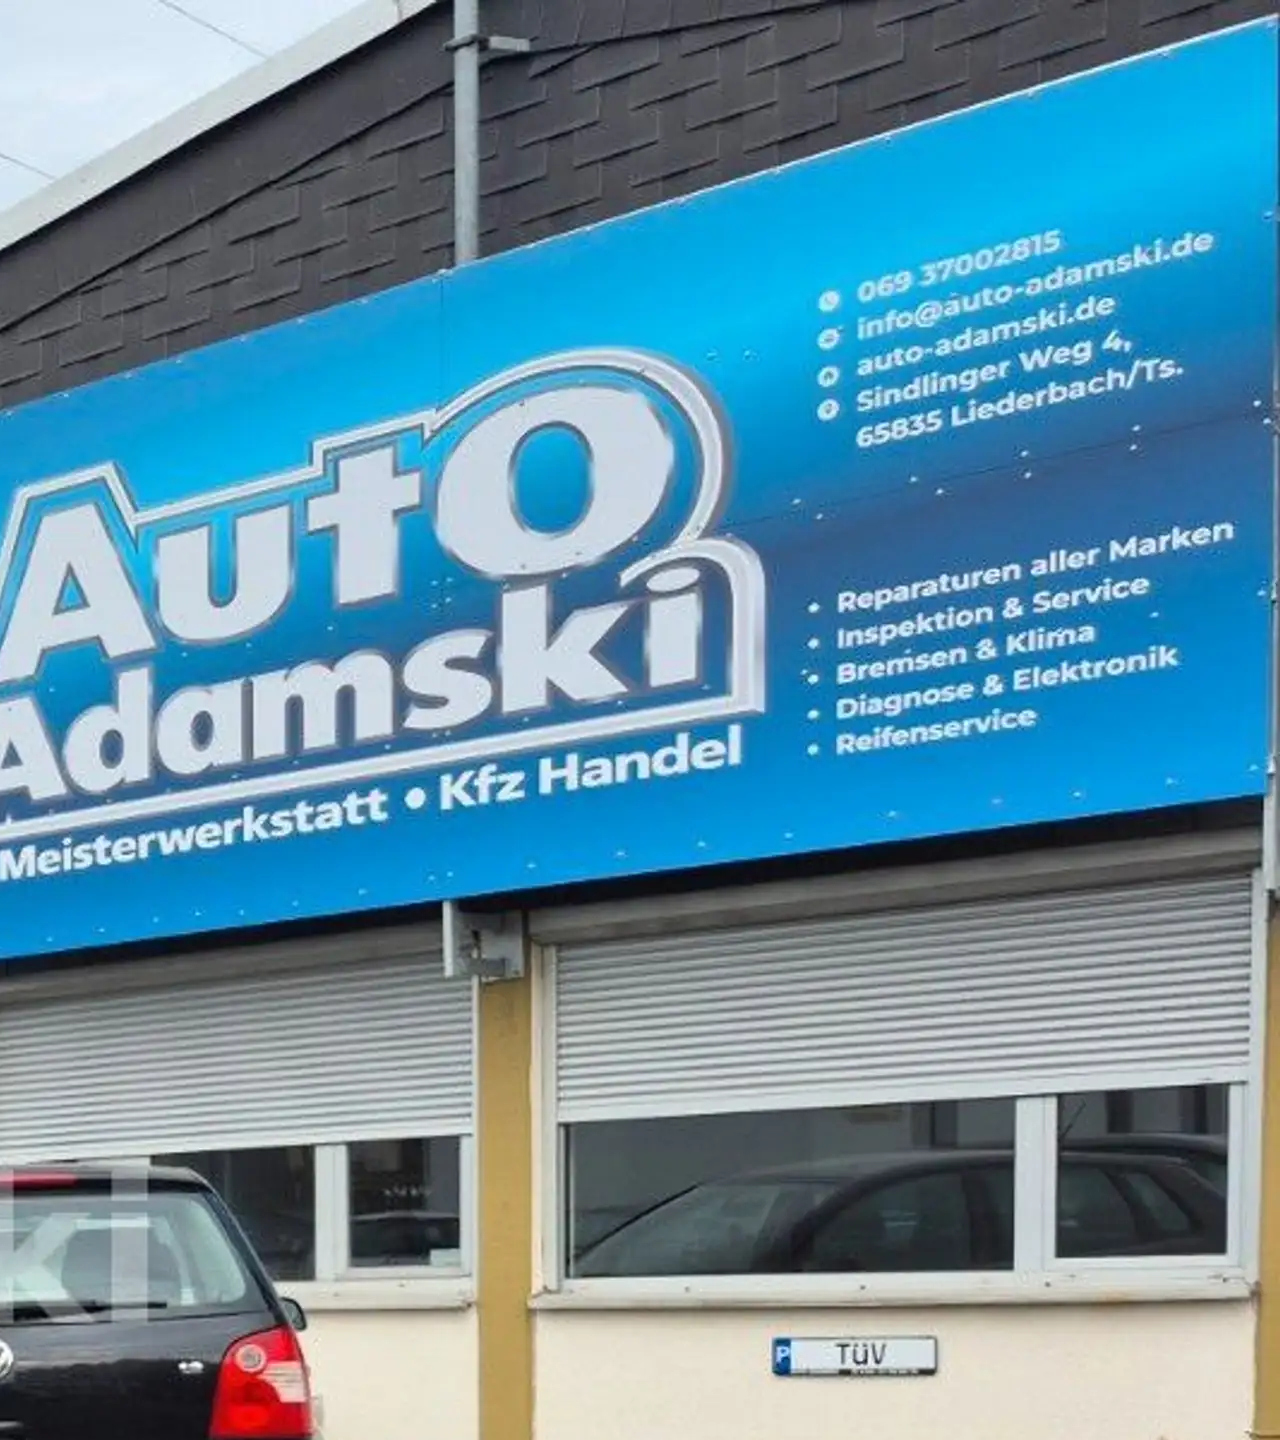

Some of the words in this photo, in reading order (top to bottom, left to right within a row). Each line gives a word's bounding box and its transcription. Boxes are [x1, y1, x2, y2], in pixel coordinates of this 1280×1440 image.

[857, 230, 1215, 340] info@auto-adamski.de
[858, 271, 913, 302] 069
[919, 229, 1062, 286] 37002815
[856, 358, 1011, 412] Sindlinger
[1019, 338, 1092, 372] Weg
[1101, 329, 1133, 352] 4,
[857, 295, 1116, 377] auto-adamski.de
[856, 409, 942, 448] 65835
[950, 356, 1184, 427] Liederbach/Ts.
[837, 560, 1022, 614] Reparaturen
[1030, 545, 1102, 577] aller
[1109, 518, 1235, 562] Marken
[837, 603, 994, 650] Inspektion
[1002, 596, 1024, 620] &
[1032, 575, 1151, 613] Service
[837, 647, 968, 686] Bremsen
[976, 637, 997, 660] &
[1006, 622, 1097, 656] Klima
[837, 677, 975, 721] Diagnose
[982, 673, 1004, 696] &
[1013, 644, 1181, 691] Elektronik
[439, 767, 525, 811] Kfz
[538, 725, 742, 796] Handel
[837, 707, 1039, 755] Reifenservice
